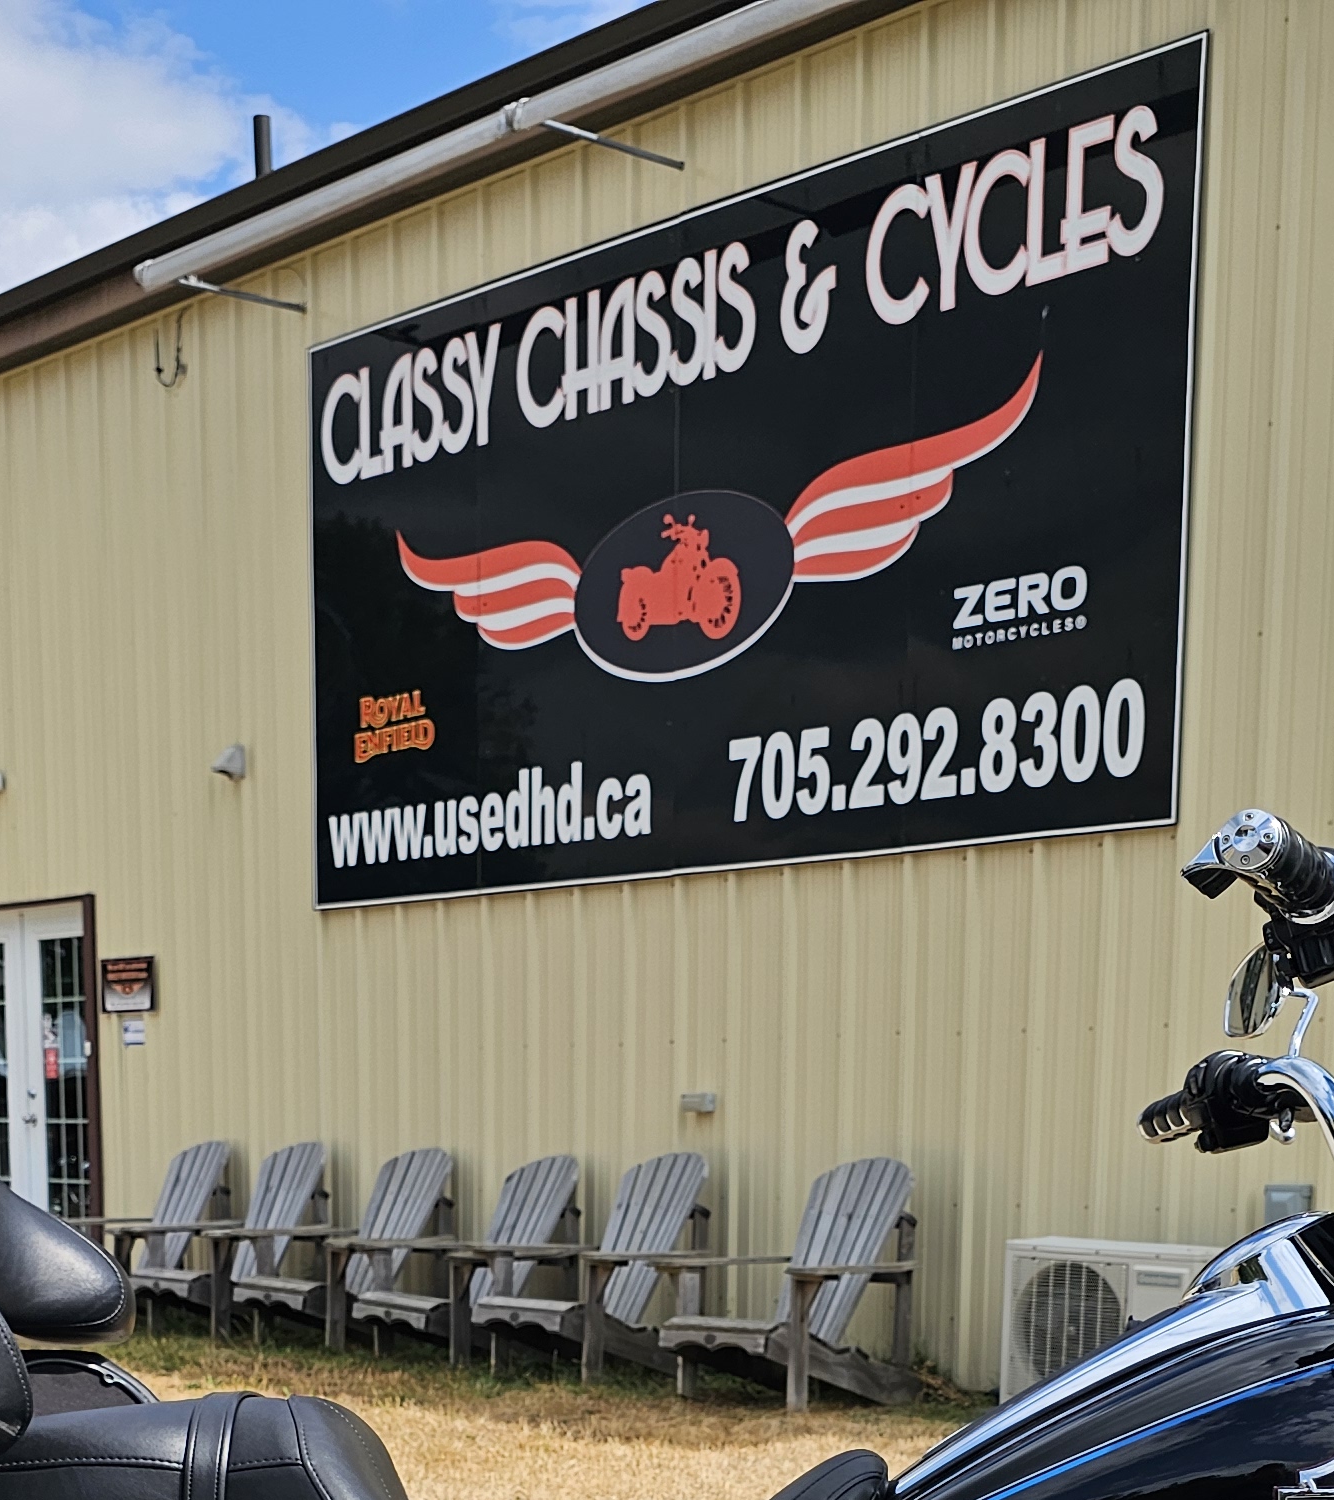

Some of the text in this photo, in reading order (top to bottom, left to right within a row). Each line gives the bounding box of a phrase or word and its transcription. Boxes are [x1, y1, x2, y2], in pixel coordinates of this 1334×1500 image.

[321, 105, 1164, 485] CLASSY CHASSIS & CYCLES
[952, 565, 1088, 630] ZERO
[353, 718, 436, 764] ENFIELD
[359, 689, 427, 729] ROYAL
[728, 678, 1146, 823] 705.292.8300
[328, 760, 652, 868] www.usedhd.ca
